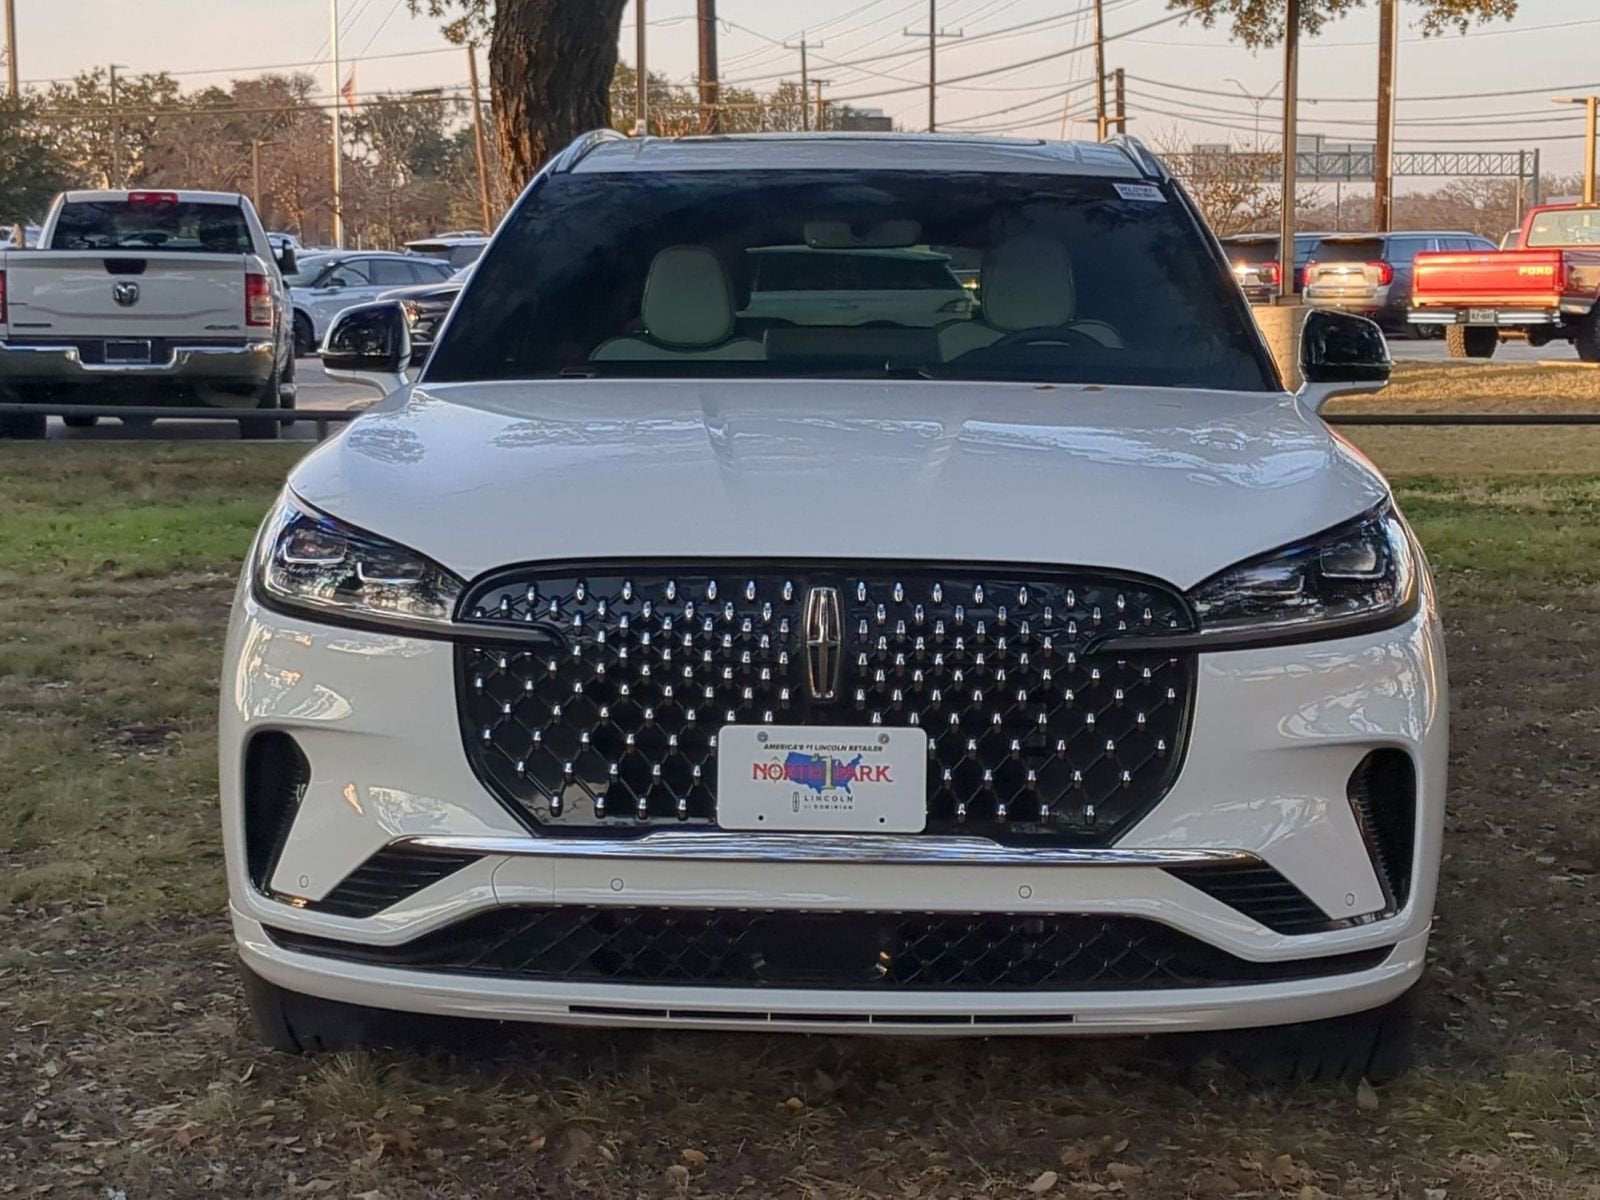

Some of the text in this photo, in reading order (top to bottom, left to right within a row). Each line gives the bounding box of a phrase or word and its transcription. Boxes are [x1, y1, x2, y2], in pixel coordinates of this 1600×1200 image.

[1519, 265, 1553, 276] FORD
[763, 743, 804, 751] AMERICA'S
[814, 744, 847, 752] LINCOLN
[848, 745, 883, 753] RETAILER
